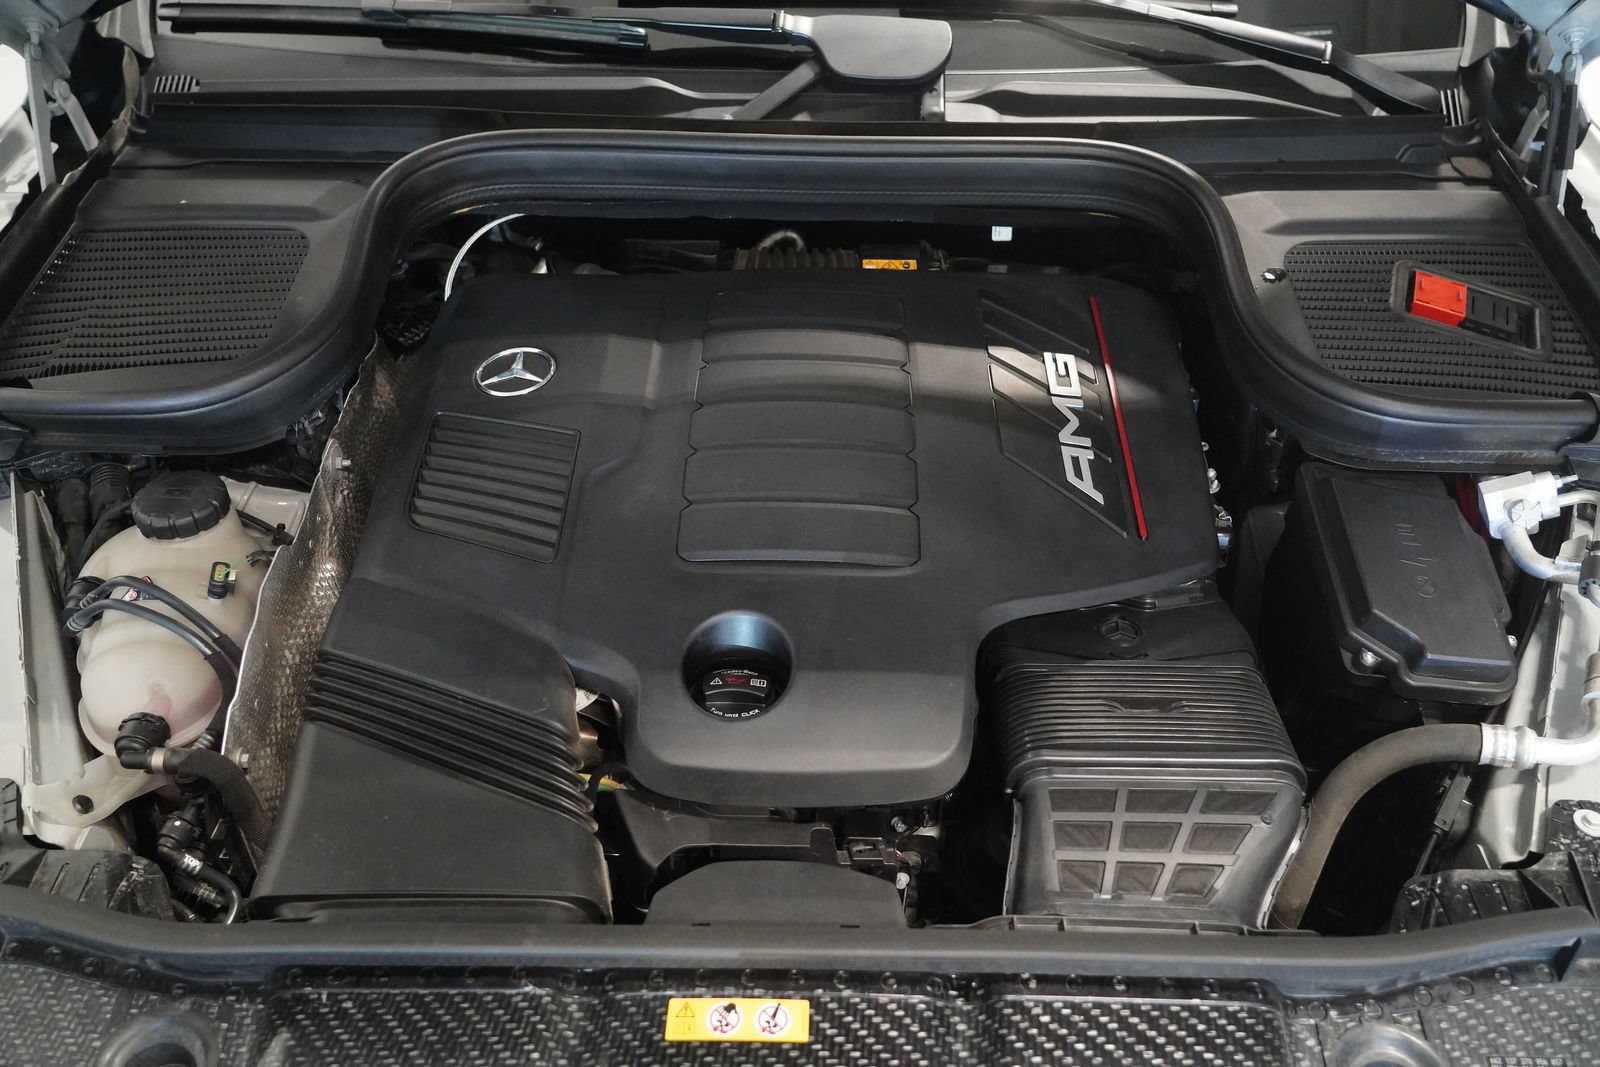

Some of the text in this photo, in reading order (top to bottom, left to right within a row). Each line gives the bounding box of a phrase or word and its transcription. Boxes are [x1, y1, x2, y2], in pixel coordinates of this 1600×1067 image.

[1043, 352, 1104, 505] AMG
[710, 707, 723, 716] Turn
[741, 708, 760, 717] CLICK
